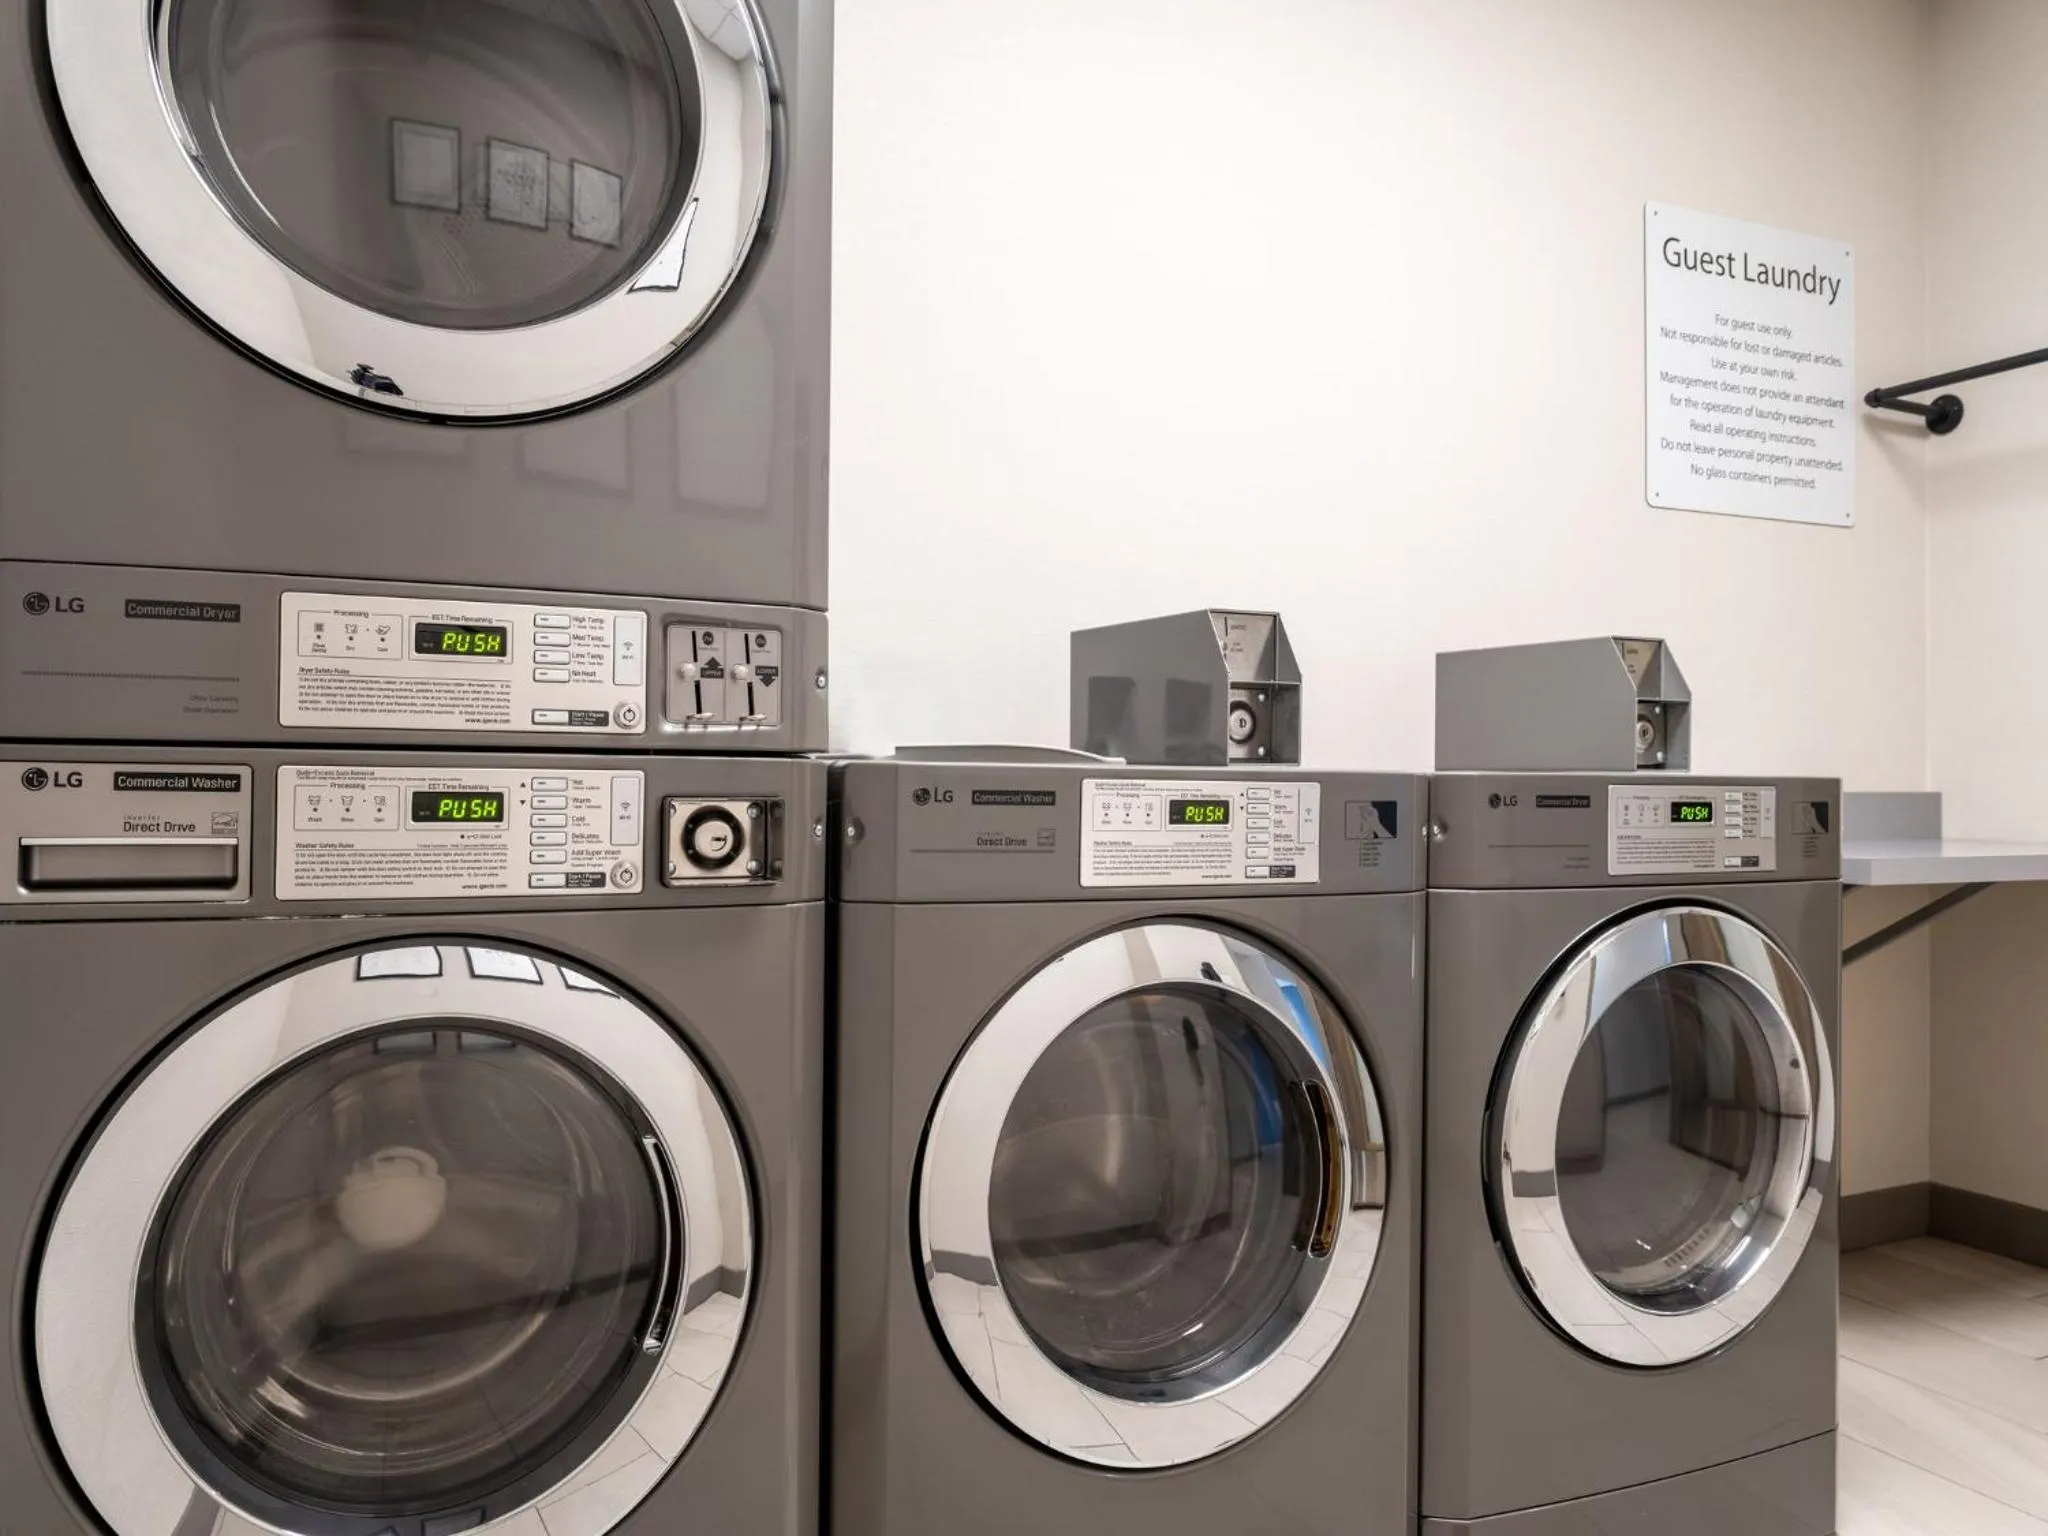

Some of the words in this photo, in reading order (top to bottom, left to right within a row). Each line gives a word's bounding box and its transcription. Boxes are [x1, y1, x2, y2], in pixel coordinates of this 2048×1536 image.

[1663, 236, 1736, 279] Guest
[1744, 252, 1841, 306] Laundry
[1715, 313, 1729, 326] For
[1730, 318, 1755, 331] guest
[1757, 323, 1771, 334] use
[1660, 327, 1677, 340] Not
[1679, 331, 1729, 350] responsible
[1730, 337, 1743, 350] for
[1744, 340, 1759, 353] lost
[1761, 345, 1771, 354] or
[1772, 345, 1812, 363] damaged
[1711, 356, 1727, 370] Use
[1729, 361, 1738, 371] at
[1739, 364, 1759, 375] your
[1761, 367, 1779, 378] own
[1781, 367, 1797, 381] risk.
[1660, 370, 1719, 389] Management
[1720, 380, 1741, 394] does
[1743, 386, 1758, 396] not
[1759, 386, 1791, 401] provide
[1793, 393, 1803, 402] an
[1805, 394, 1844, 409] attendant
[1670, 394, 1682, 406] for
[1684, 395, 1699, 409] the
[1701, 400, 1743, 416] operation
[1744, 405, 1754, 417] of
[1755, 407, 1787, 423] laundry
[1690, 418, 1712, 433] Read
[1713, 423, 1724, 435] all
[1725, 425, 1767, 442] operating
[1660, 437, 1675, 450] Do
[1676, 441, 1692, 453] not
[1693, 443, 1716, 456] leave
[1718, 446, 1755, 461] personal
[1756, 452, 1793, 468] property
[1690, 464, 1704, 476] No
[1706, 467, 1727, 480] glass
[1728, 470, 1772, 485] containers
[55, 596, 85, 613] LG
[127, 602, 200, 617] Commercial
[203, 605, 238, 621] Dryer
[442, 632, 501, 652] PUSH
[53, 771, 83, 788] LG
[118, 776, 189, 788] Commercial
[192, 776, 238, 789] Washer
[330, 782, 366, 790] Processing
[934, 787, 954, 803] LG
[1503, 795, 1517, 807] LG
[439, 799, 497, 818] PUSH
[1185, 806, 1224, 822] PUSH
[1680, 806, 1709, 820] PUSH
[123, 821, 161, 833] Direct
[164, 821, 196, 833] Drive
[977, 836, 1003, 847] Direct
[1005, 836, 1027, 847] Drive
